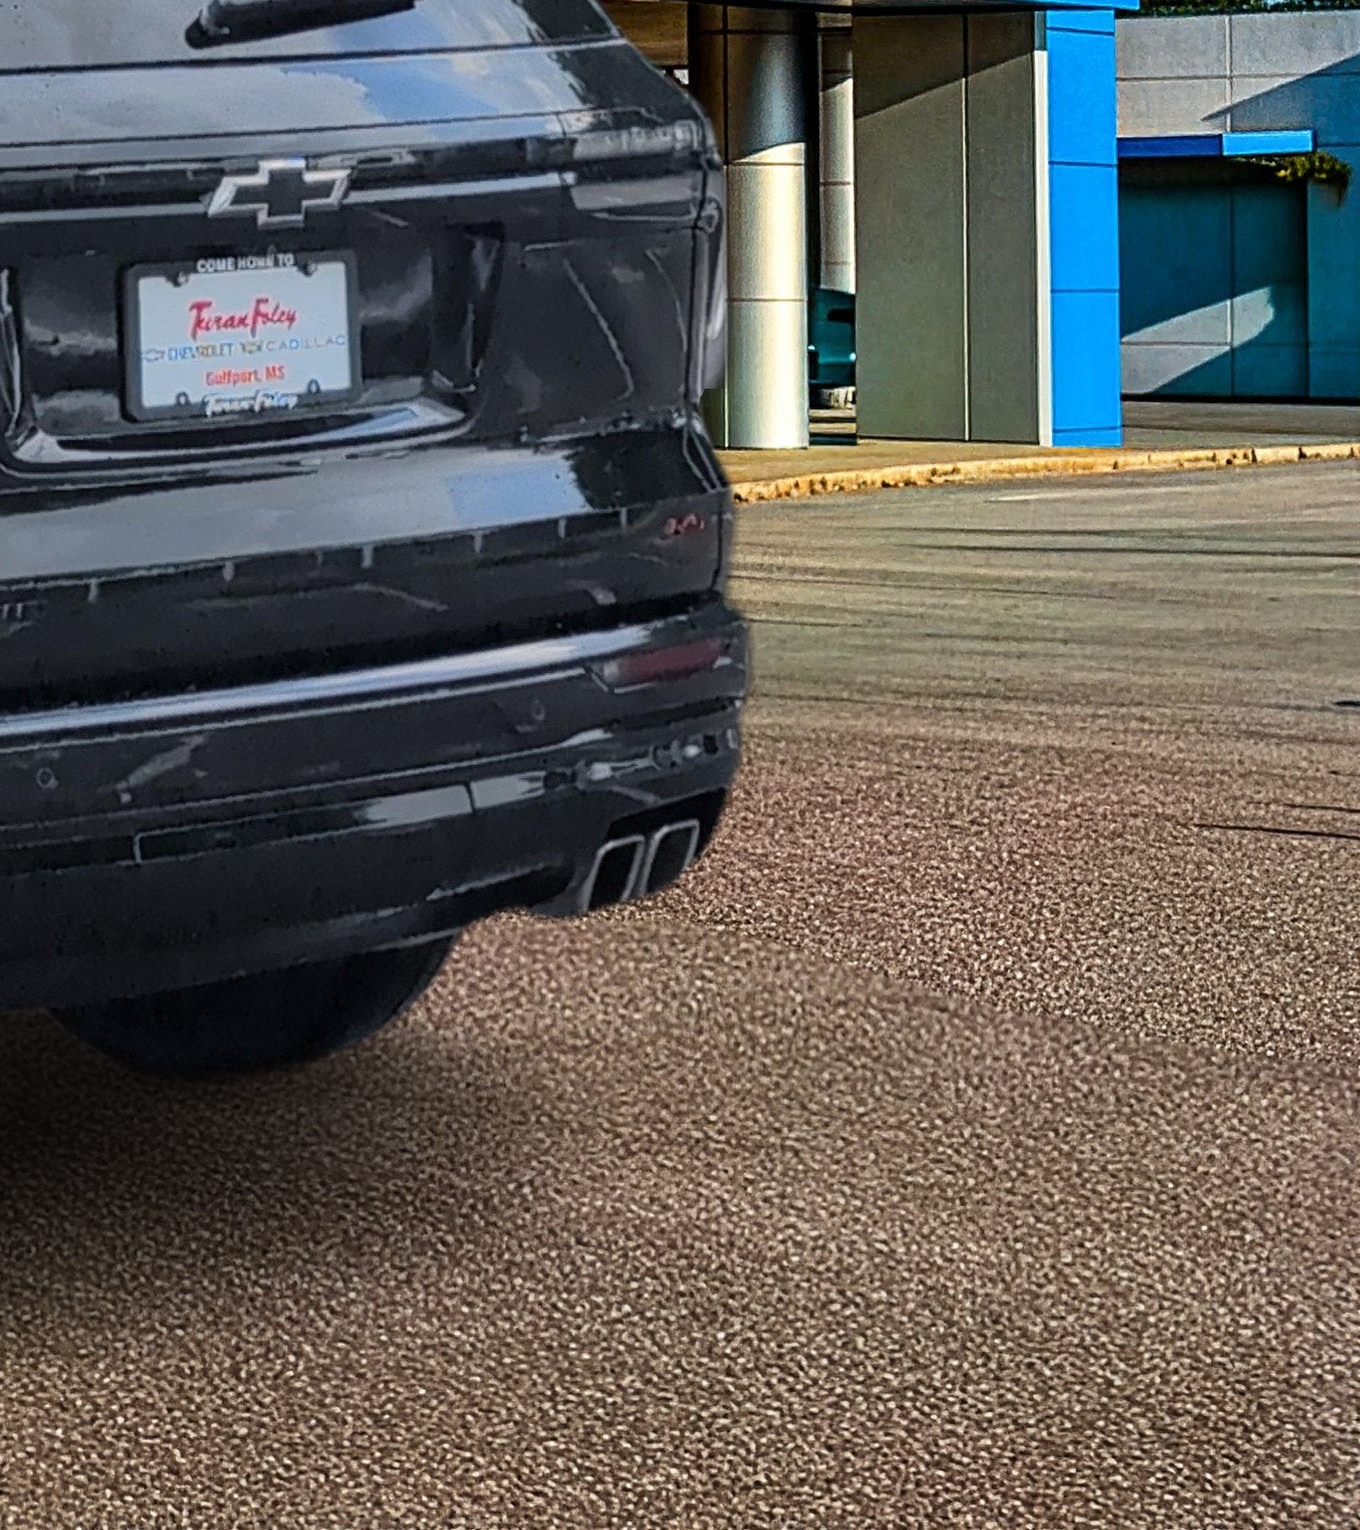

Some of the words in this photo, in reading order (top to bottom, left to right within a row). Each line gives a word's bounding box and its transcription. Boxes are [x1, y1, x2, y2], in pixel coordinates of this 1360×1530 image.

[196, 256, 236, 273] COME
[276, 252, 294, 268] TO
[265, 365, 286, 381] MS
